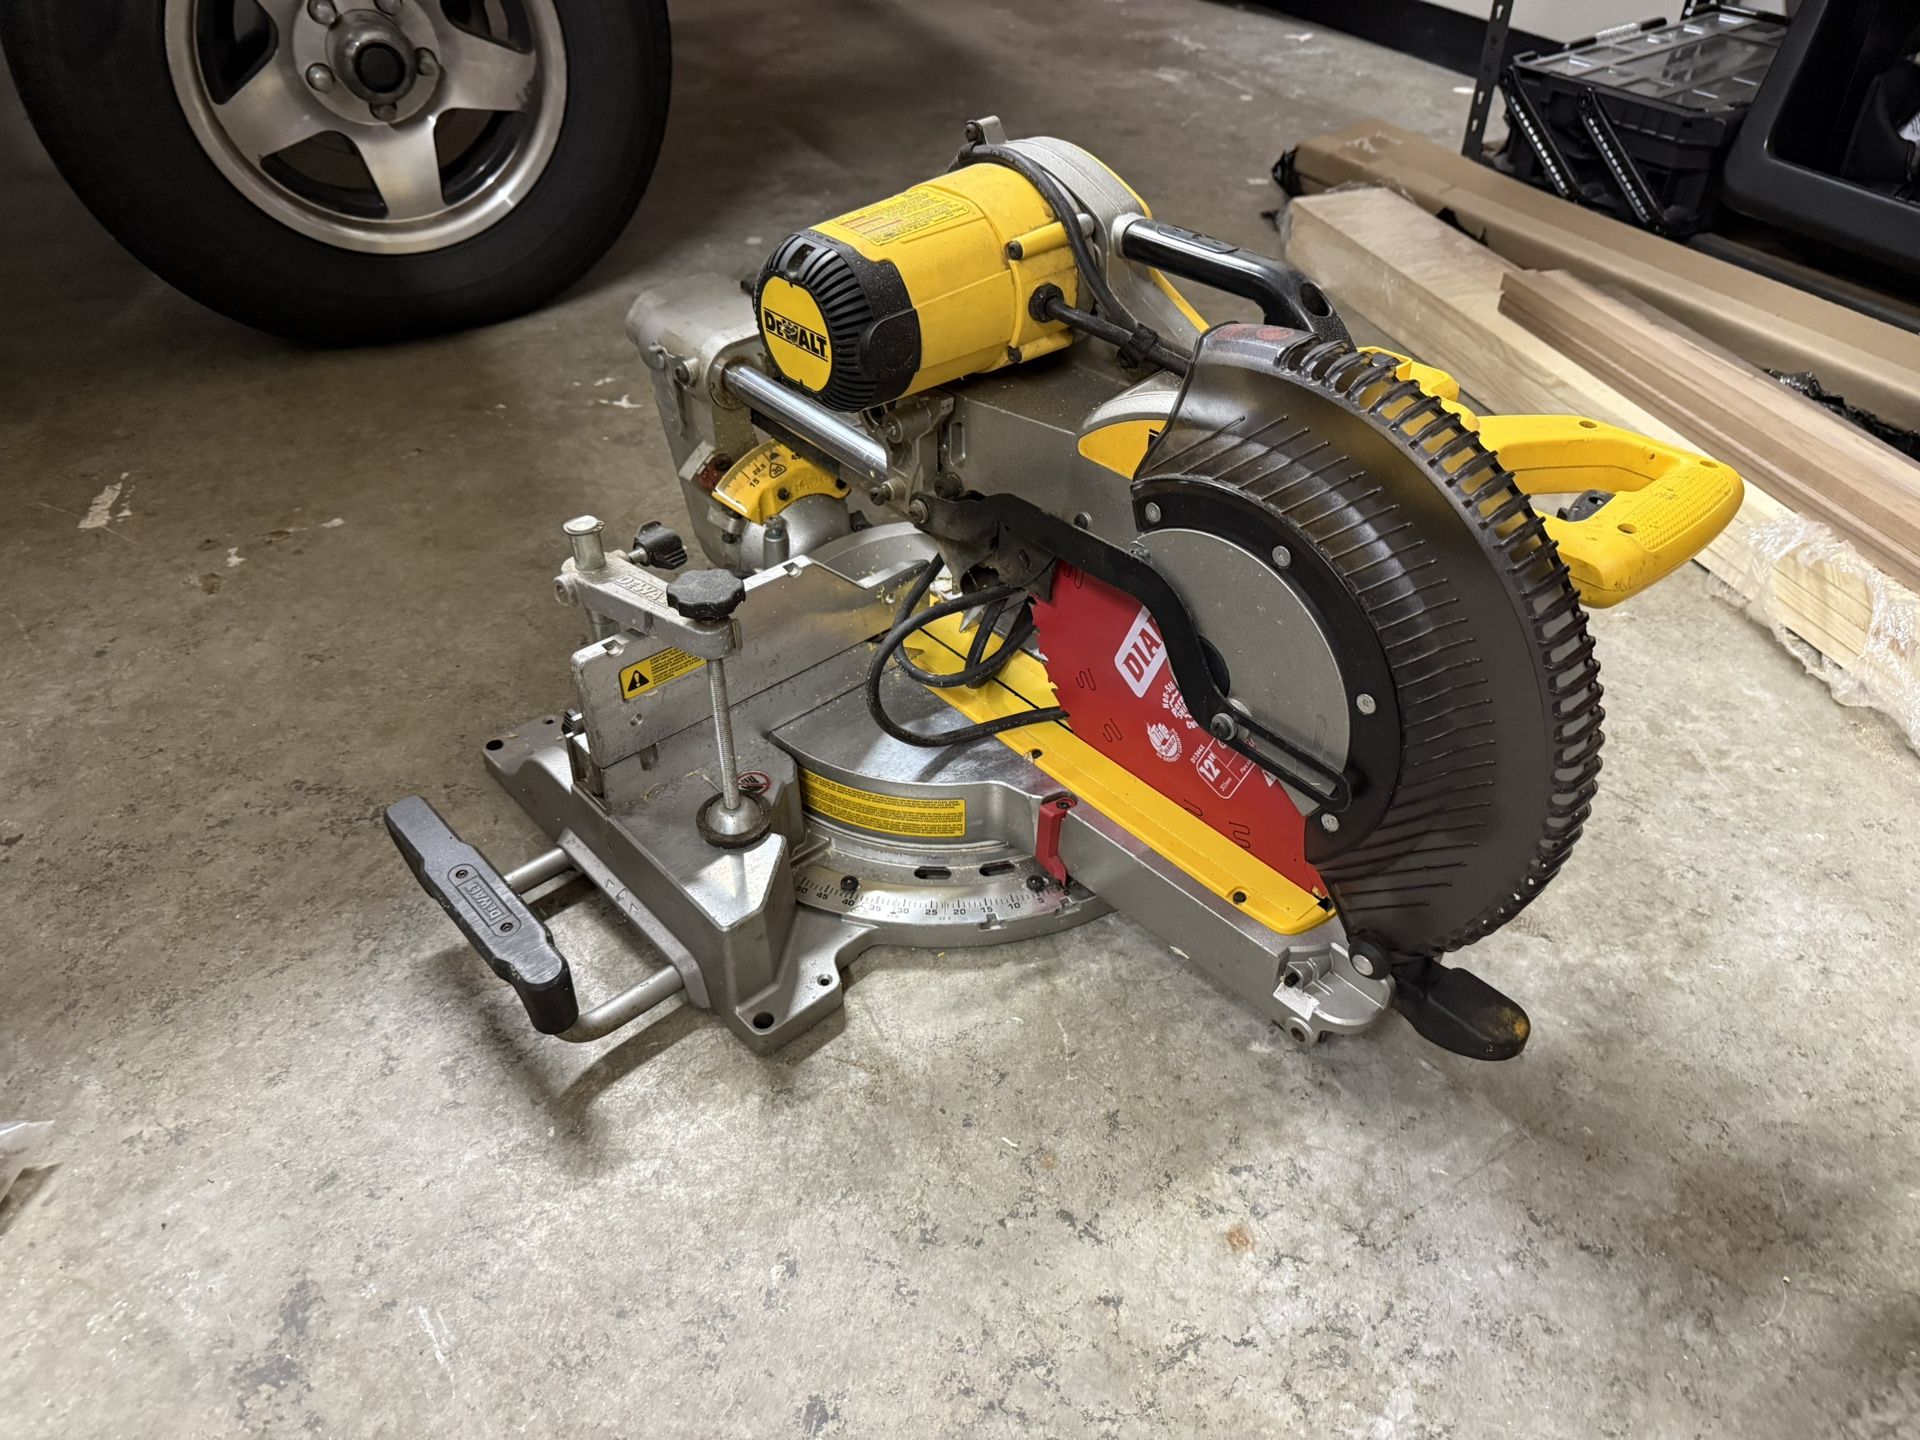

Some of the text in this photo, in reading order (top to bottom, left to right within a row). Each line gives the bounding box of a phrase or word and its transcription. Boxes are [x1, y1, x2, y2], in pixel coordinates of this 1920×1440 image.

[752, 463, 767, 476] 22.5
[771, 465, 783, 476] 30
[749, 478, 761, 489] 15
[1199, 753, 1220, 782] 12"
[467, 882, 503, 920] DEWALT
[816, 892, 829, 900] 45
[842, 899, 855, 907] 40
[868, 904, 882, 912] 35
[896, 907, 910, 915] 30
[925, 908, 938, 916] 25
[953, 908, 966, 916] 20
[981, 906, 994, 914] 15
[1007, 902, 1021, 910] 10
[1037, 896, 1045, 904] 5
